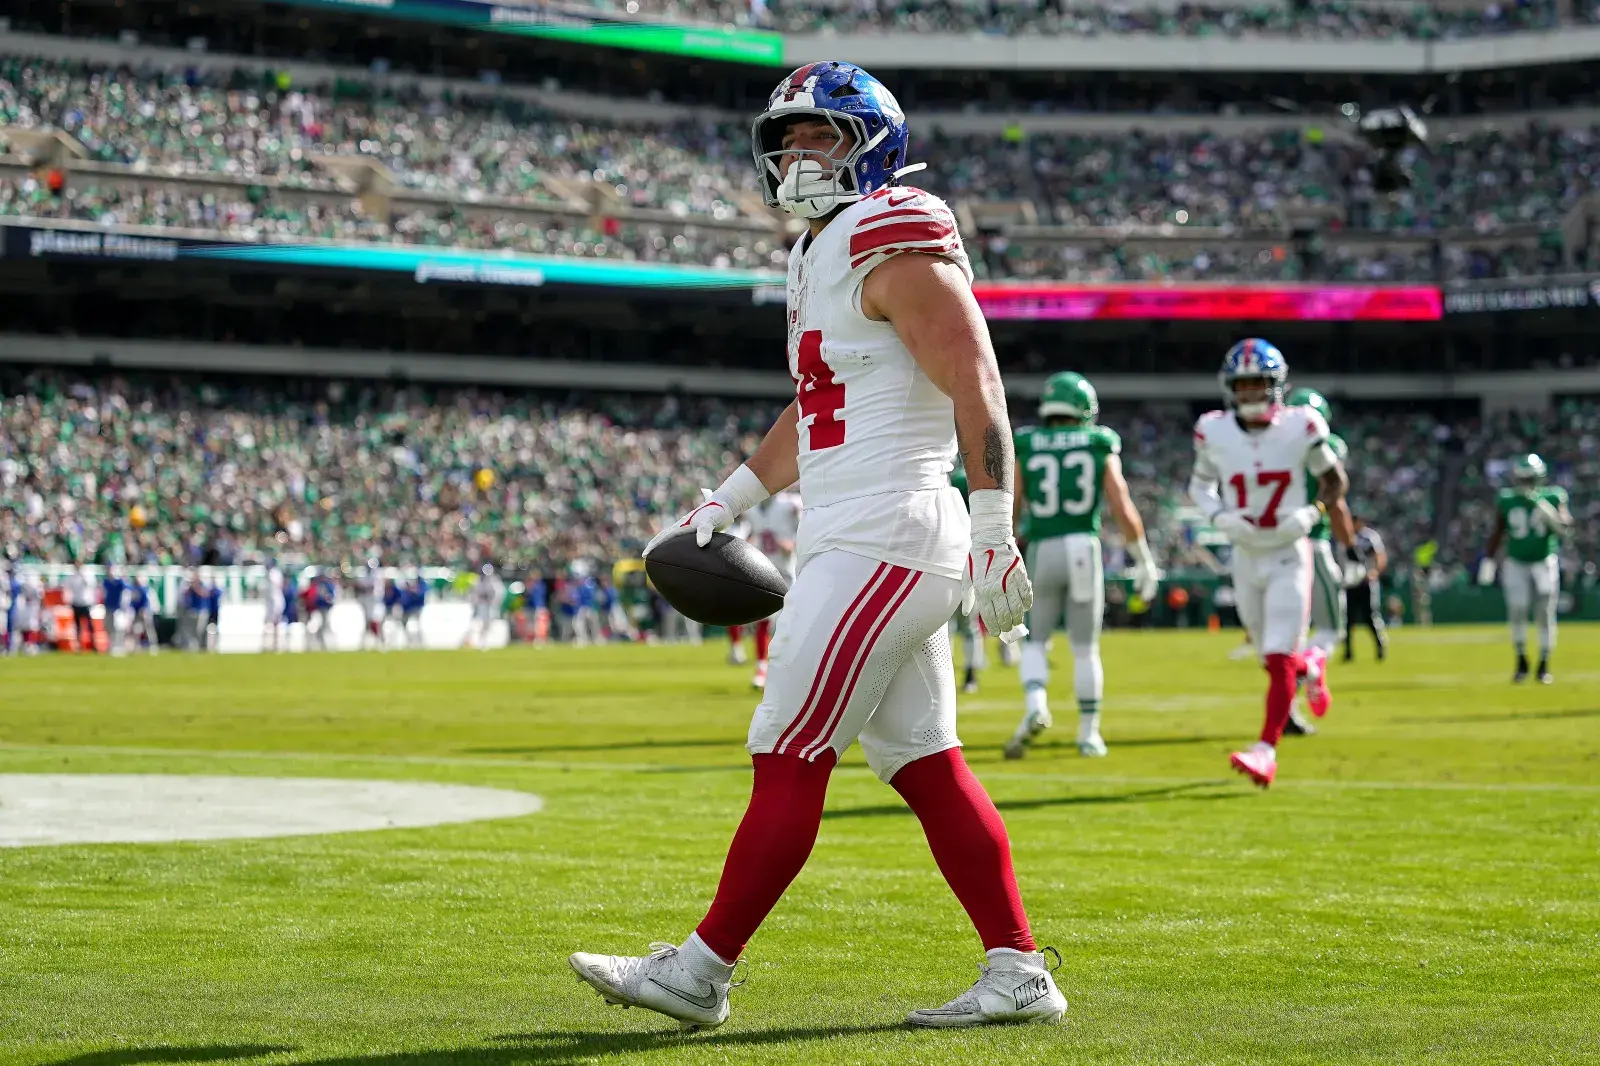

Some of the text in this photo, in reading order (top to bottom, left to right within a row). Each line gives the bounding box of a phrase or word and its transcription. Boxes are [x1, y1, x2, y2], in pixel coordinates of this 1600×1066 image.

[785, 329, 846, 451] 4
[1026, 450, 1096, 518] 33
[1229, 469, 1291, 528] 17
[1013, 973, 1049, 1011] NIKE
